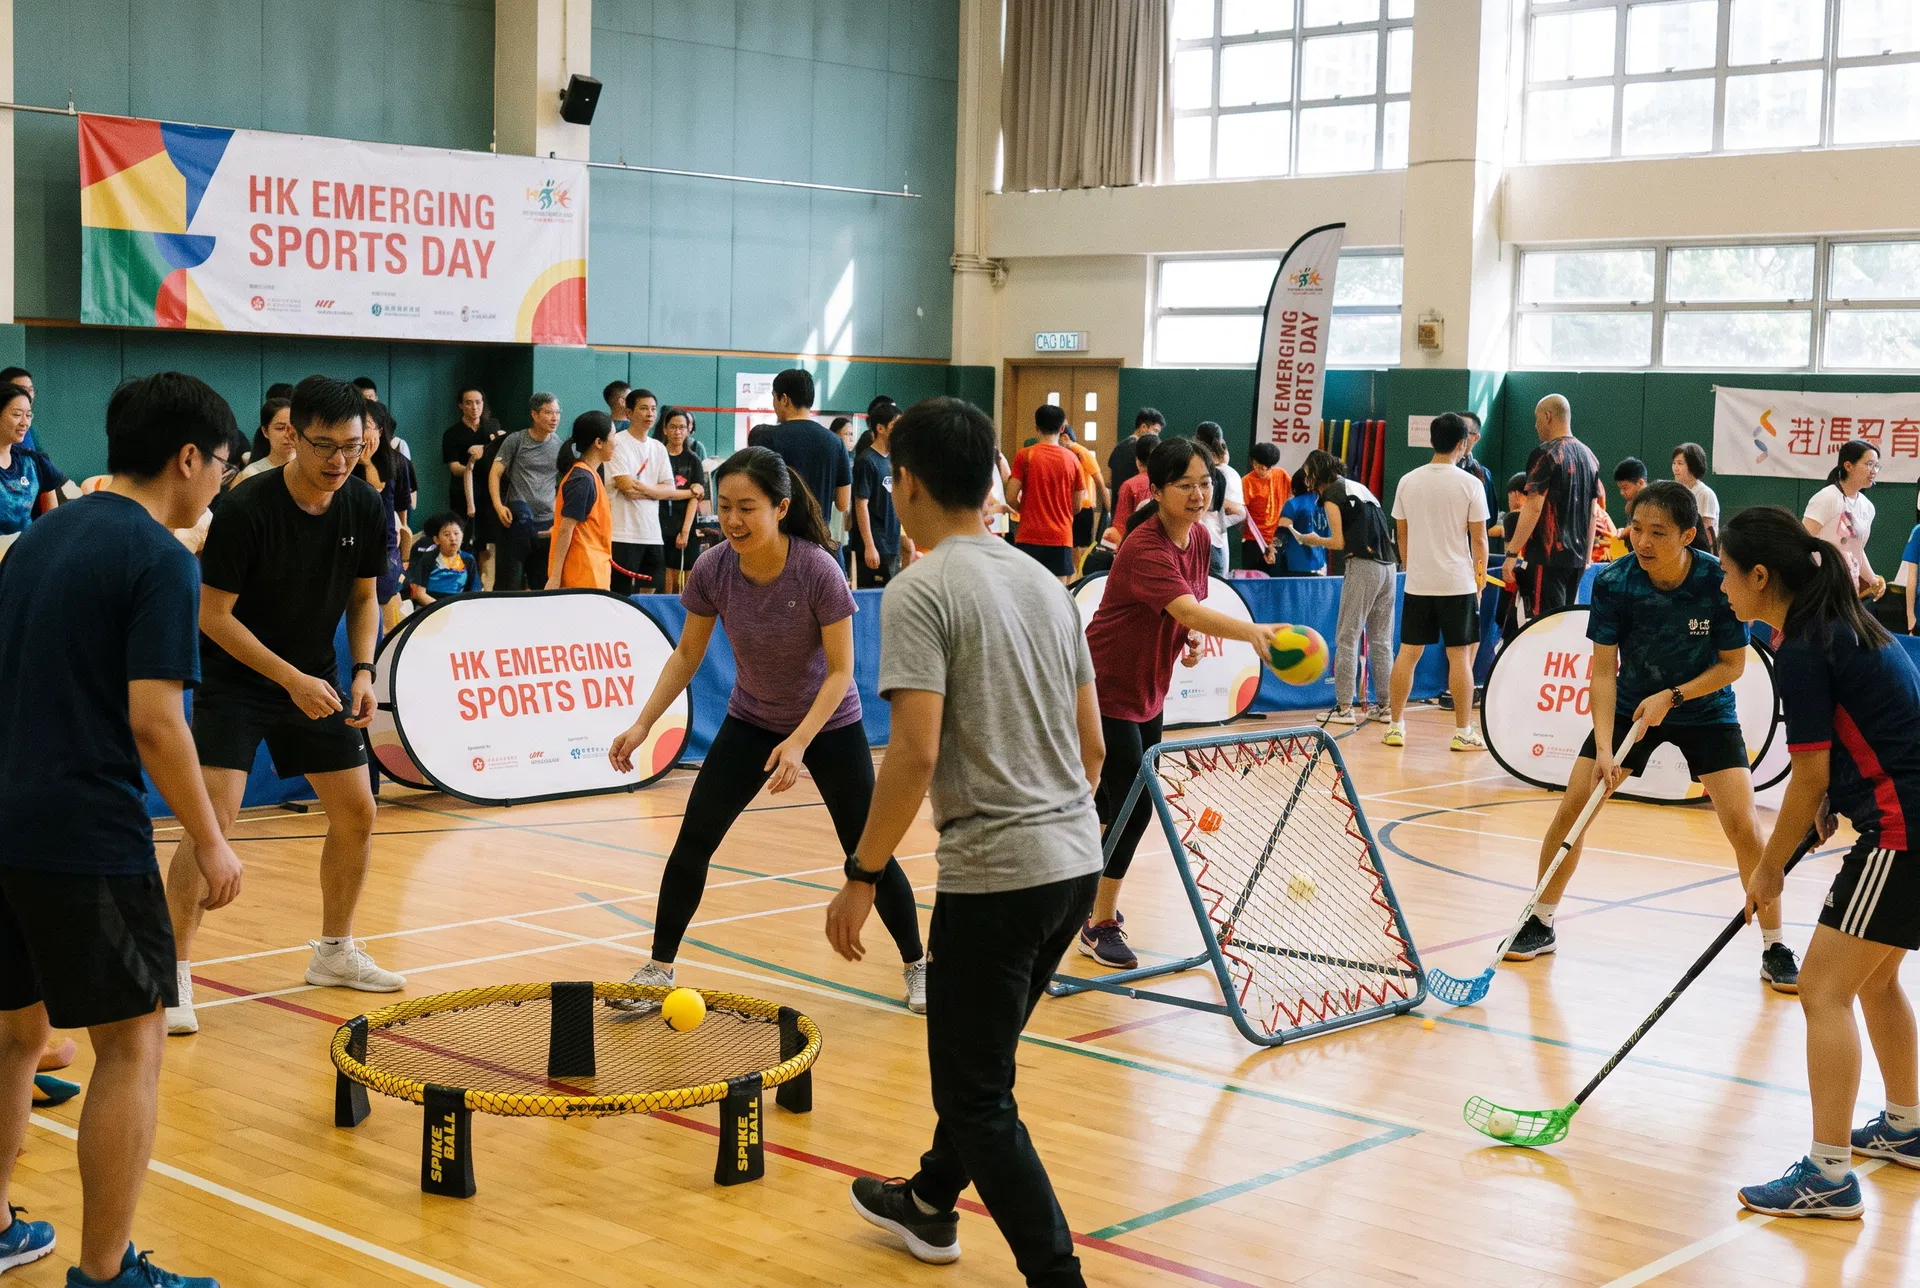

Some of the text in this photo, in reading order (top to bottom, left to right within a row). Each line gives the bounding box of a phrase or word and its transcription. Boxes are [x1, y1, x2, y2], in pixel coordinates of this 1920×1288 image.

[250, 176, 494, 229] HK EMERGING
[250, 224, 495, 278] SPORTS DAY
[1299, 312, 1320, 354] DAY
[1272, 311, 1299, 443] HK EMERGING
[1292, 362, 1316, 444] SPORTS
[450, 642, 632, 681] HK EMERGING
[1181, 634, 1225, 658] AY
[1543, 651, 1580, 679] HK
[458, 676, 635, 720] SPORTS DAY
[1537, 683, 1592, 716] SPO
[444, 1112, 456, 1160] BALL
[737, 1116, 748, 1171] SPIKE
[749, 1097, 758, 1145] BALL
[431, 1125, 443, 1183] SPIKE
